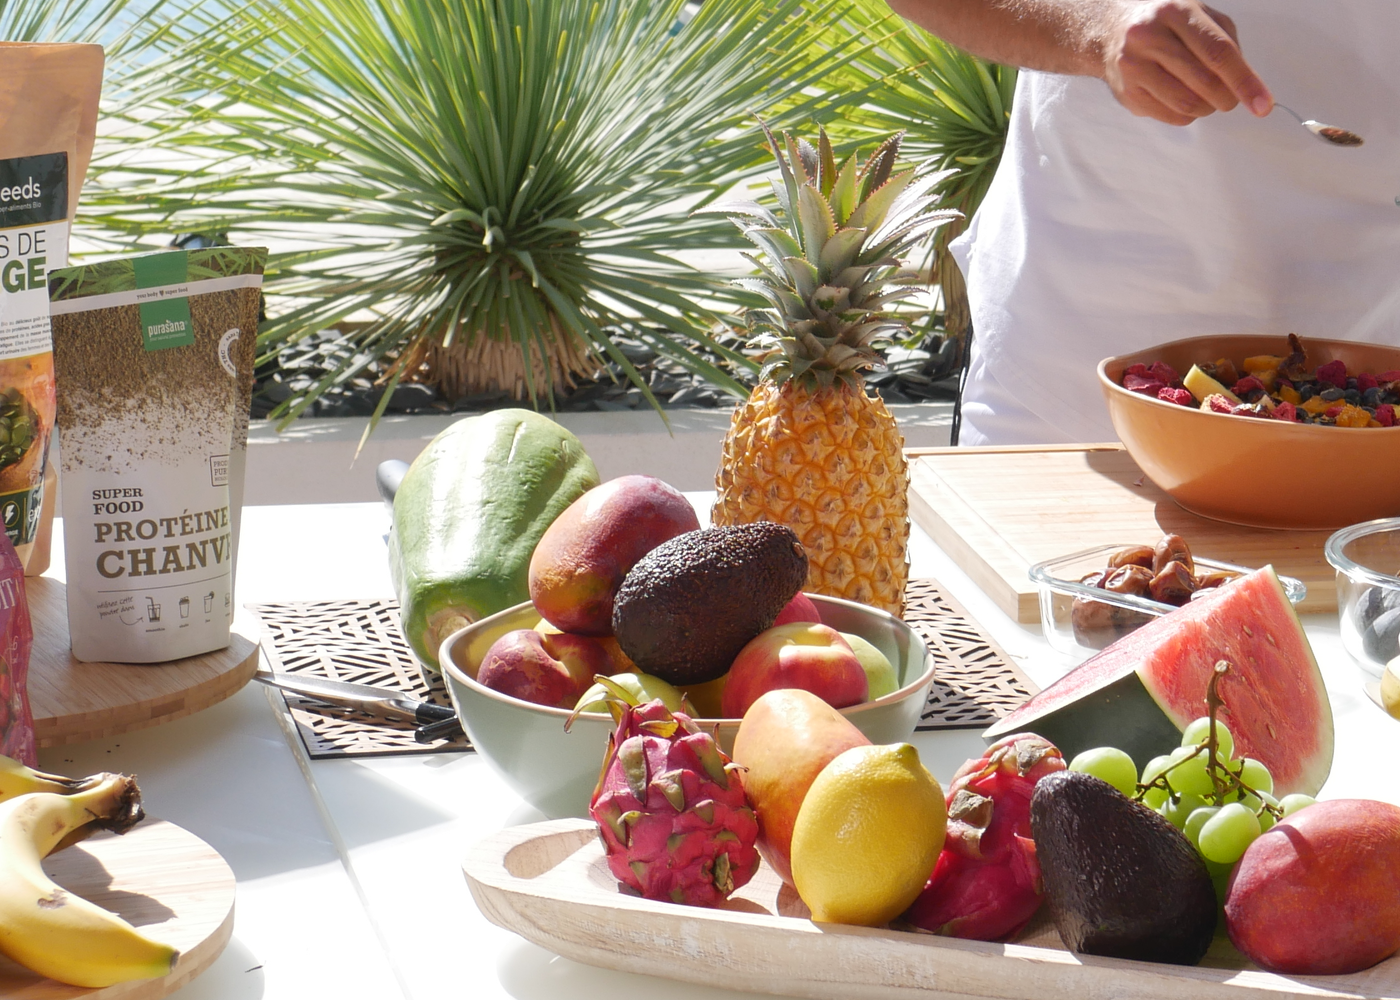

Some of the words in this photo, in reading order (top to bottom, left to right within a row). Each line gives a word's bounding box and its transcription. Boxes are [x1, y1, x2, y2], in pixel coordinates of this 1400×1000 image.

[0, 176, 41, 202] eeds
[18, 230, 46, 256] DE
[2, 256, 46, 294] GE
[92, 487, 144, 501] SUPER
[93, 500, 144, 515] FOOD
[94, 506, 229, 543] PROTÉINE
